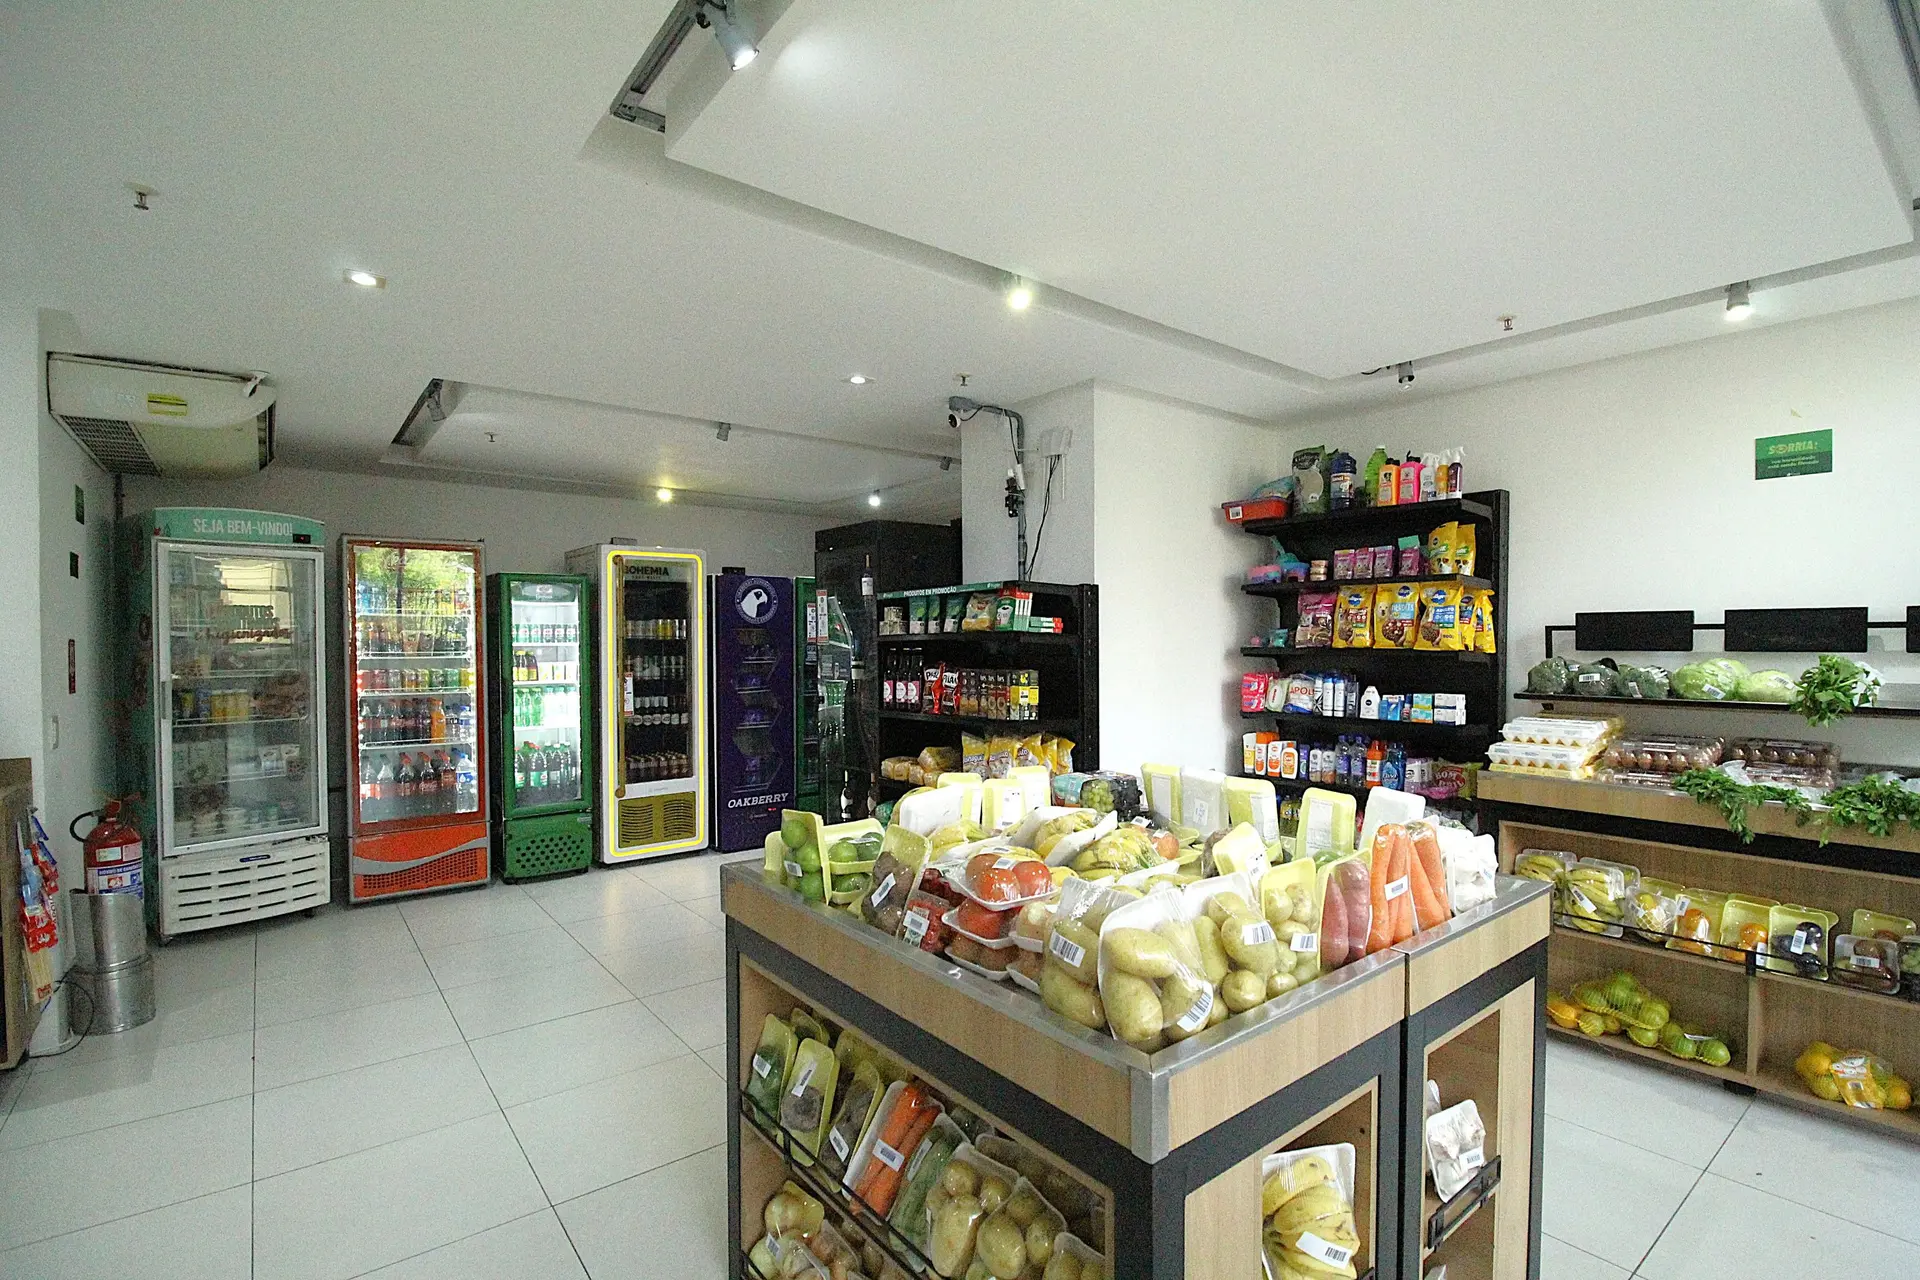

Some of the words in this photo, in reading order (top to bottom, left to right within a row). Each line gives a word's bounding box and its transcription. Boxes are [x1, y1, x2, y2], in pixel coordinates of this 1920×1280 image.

[194, 519, 223, 533] SEJA
[227, 520, 293, 536] BEM-VINDO!
[727, 792, 789, 809] OAKBERRY
